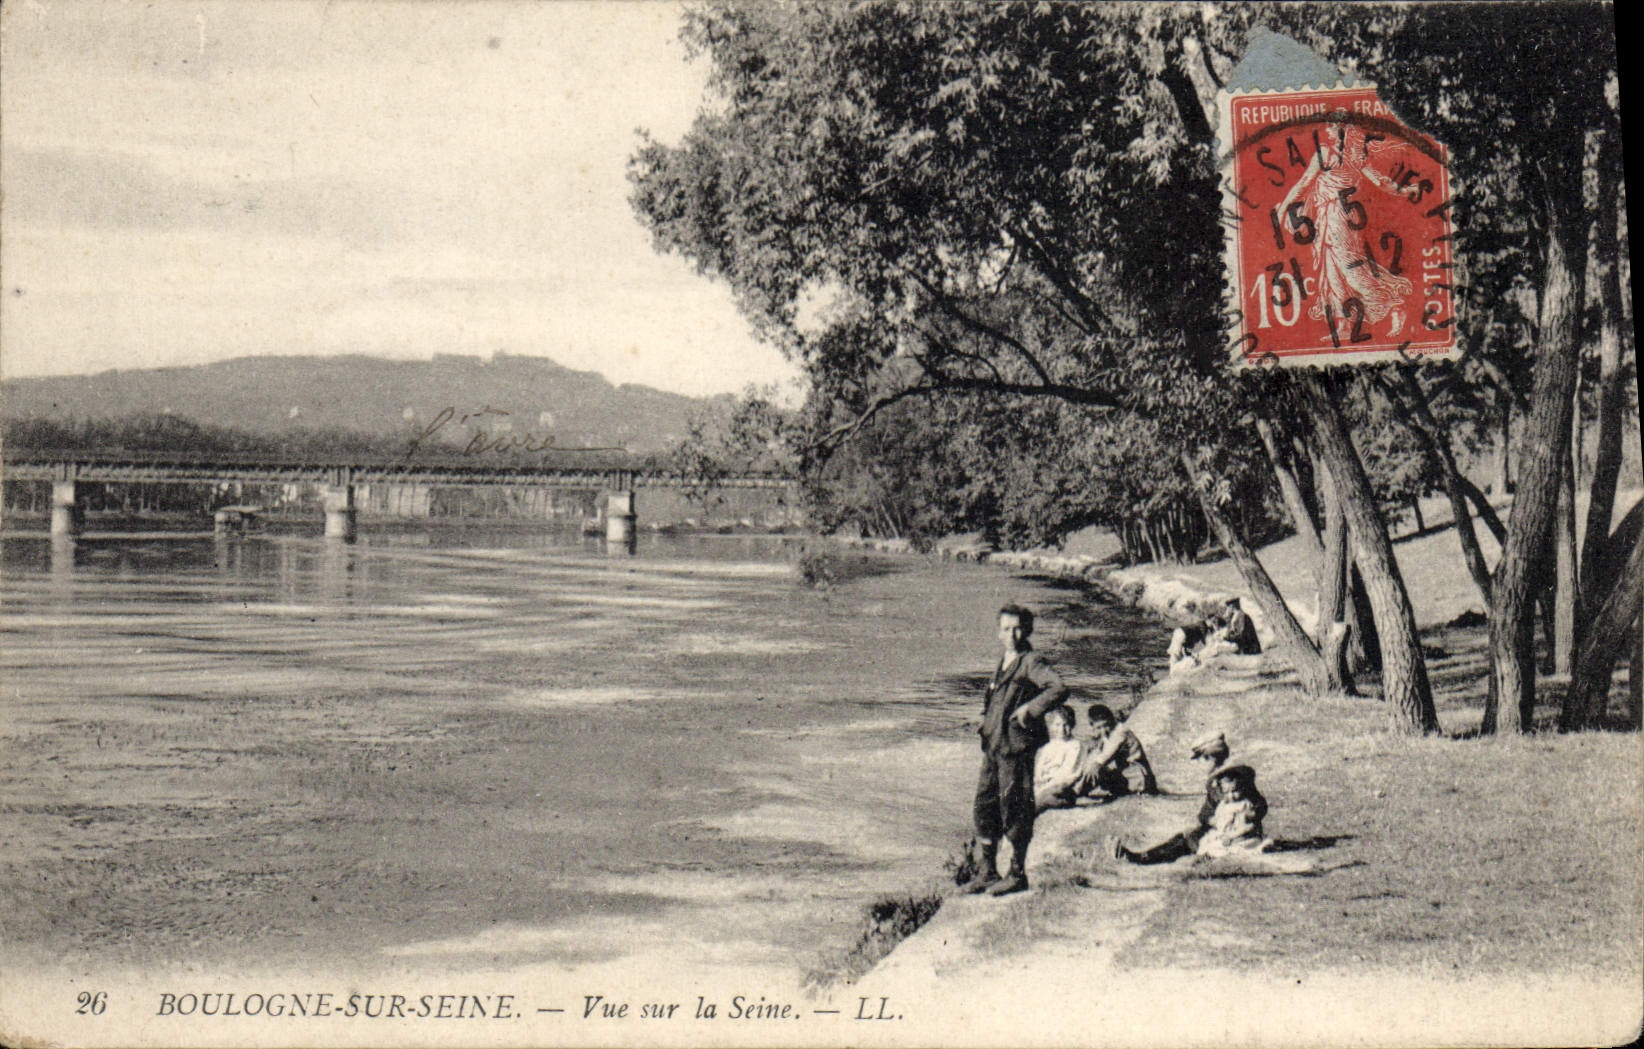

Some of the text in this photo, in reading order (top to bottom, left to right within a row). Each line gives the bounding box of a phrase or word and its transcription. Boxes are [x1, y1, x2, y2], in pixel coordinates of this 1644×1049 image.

[1270, 186, 1369, 249] 15 5
[1264, 257, 1308, 306] 31
[1324, 296, 1373, 349] 12
